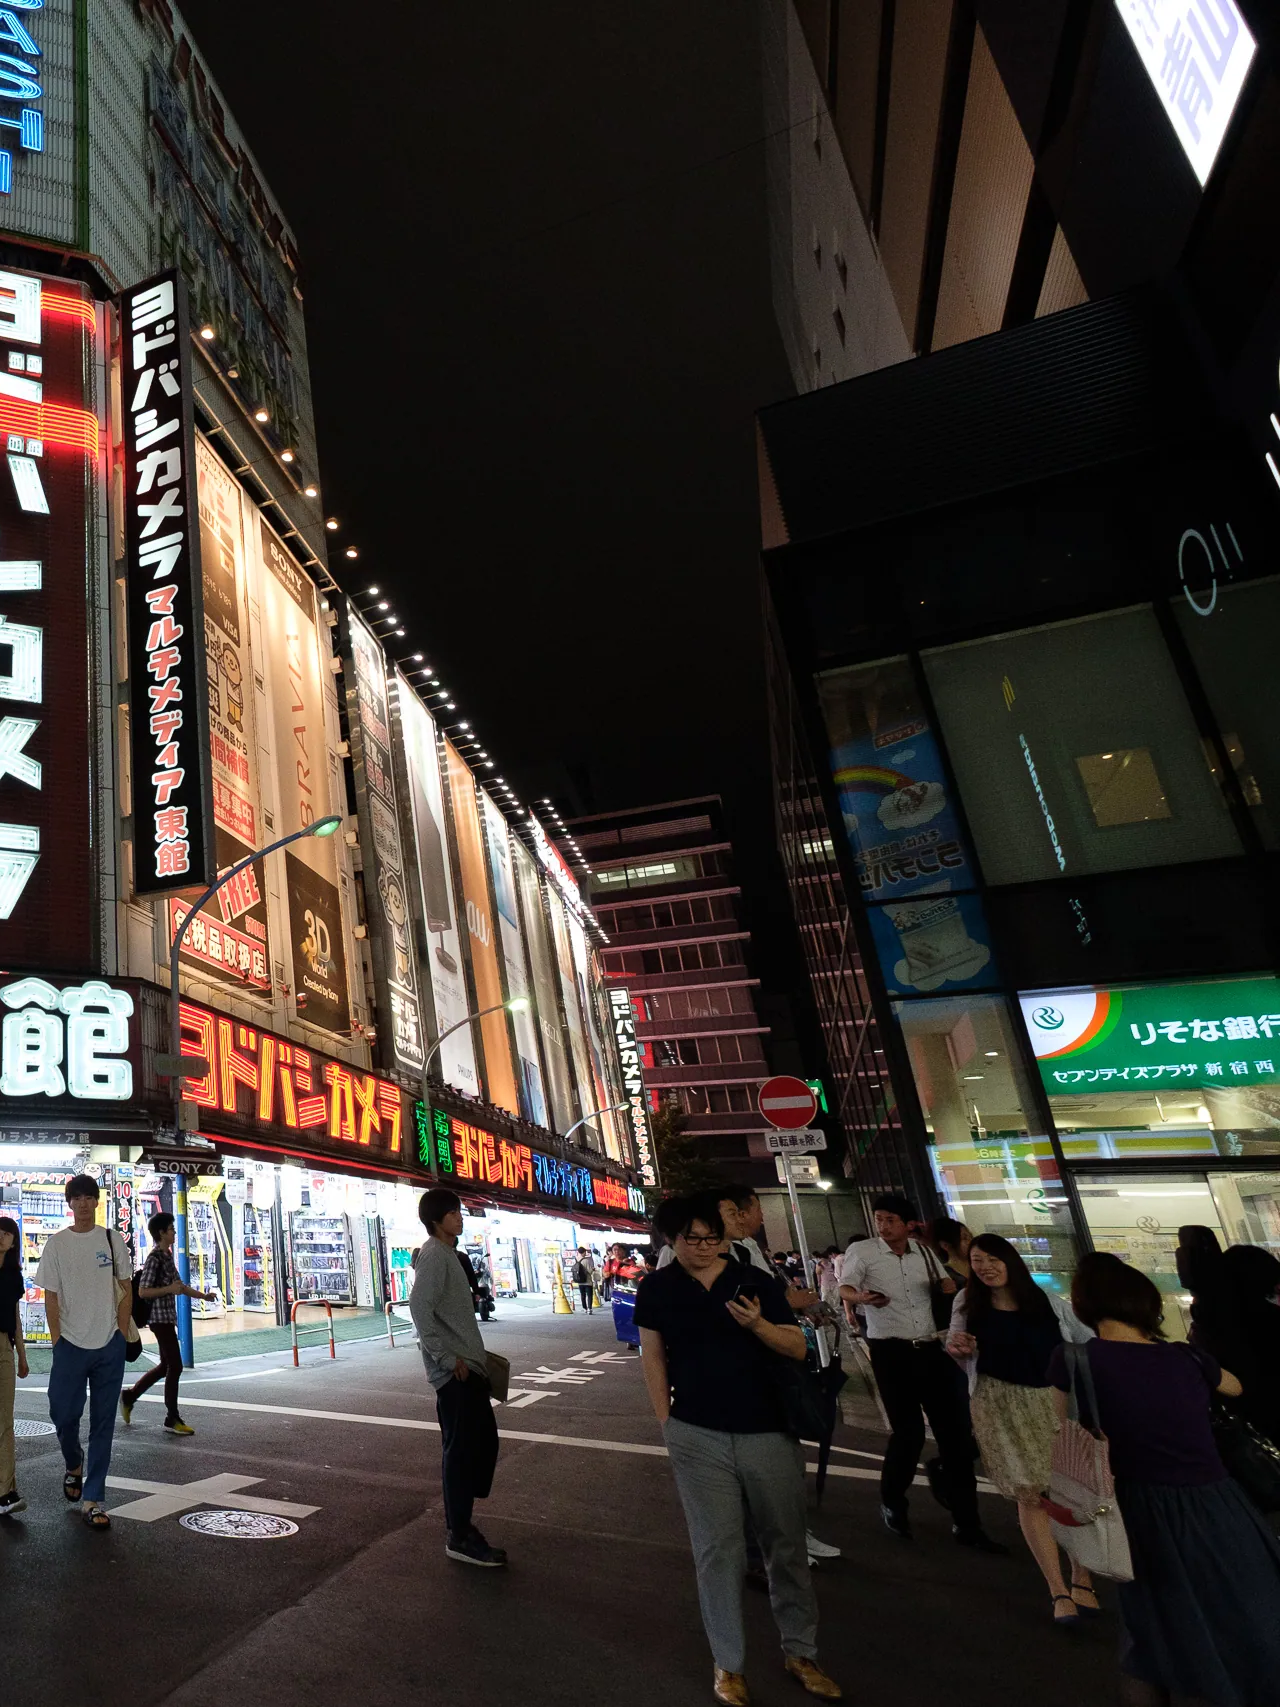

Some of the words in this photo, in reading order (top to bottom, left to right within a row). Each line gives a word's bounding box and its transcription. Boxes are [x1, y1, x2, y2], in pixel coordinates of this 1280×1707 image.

[130, 280, 184, 580] ヨドバシカメラ
[270, 542, 301, 590] SONY
[222, 614, 238, 641] VISA
[217, 857, 261, 924] FREE
[303, 909, 330, 963] 3D
[466, 900, 490, 947] au
[303, 975, 322, 996] Created
[328, 988, 339, 1004] Sony
[312, 962, 329, 979] World
[610, 989, 642, 1094] ヨドバシカメラ
[1130, 1014, 1280, 1047] りそな銀行
[180, 1001, 401, 1152] ヨドバシカメラ
[452, 1119, 532, 1192] ヨドバシカメラ
[769, 1134, 822, 1148] 自転車を除く
[158, 1161, 202, 1174] SONY
[206, 1163, 219, 1177] α
